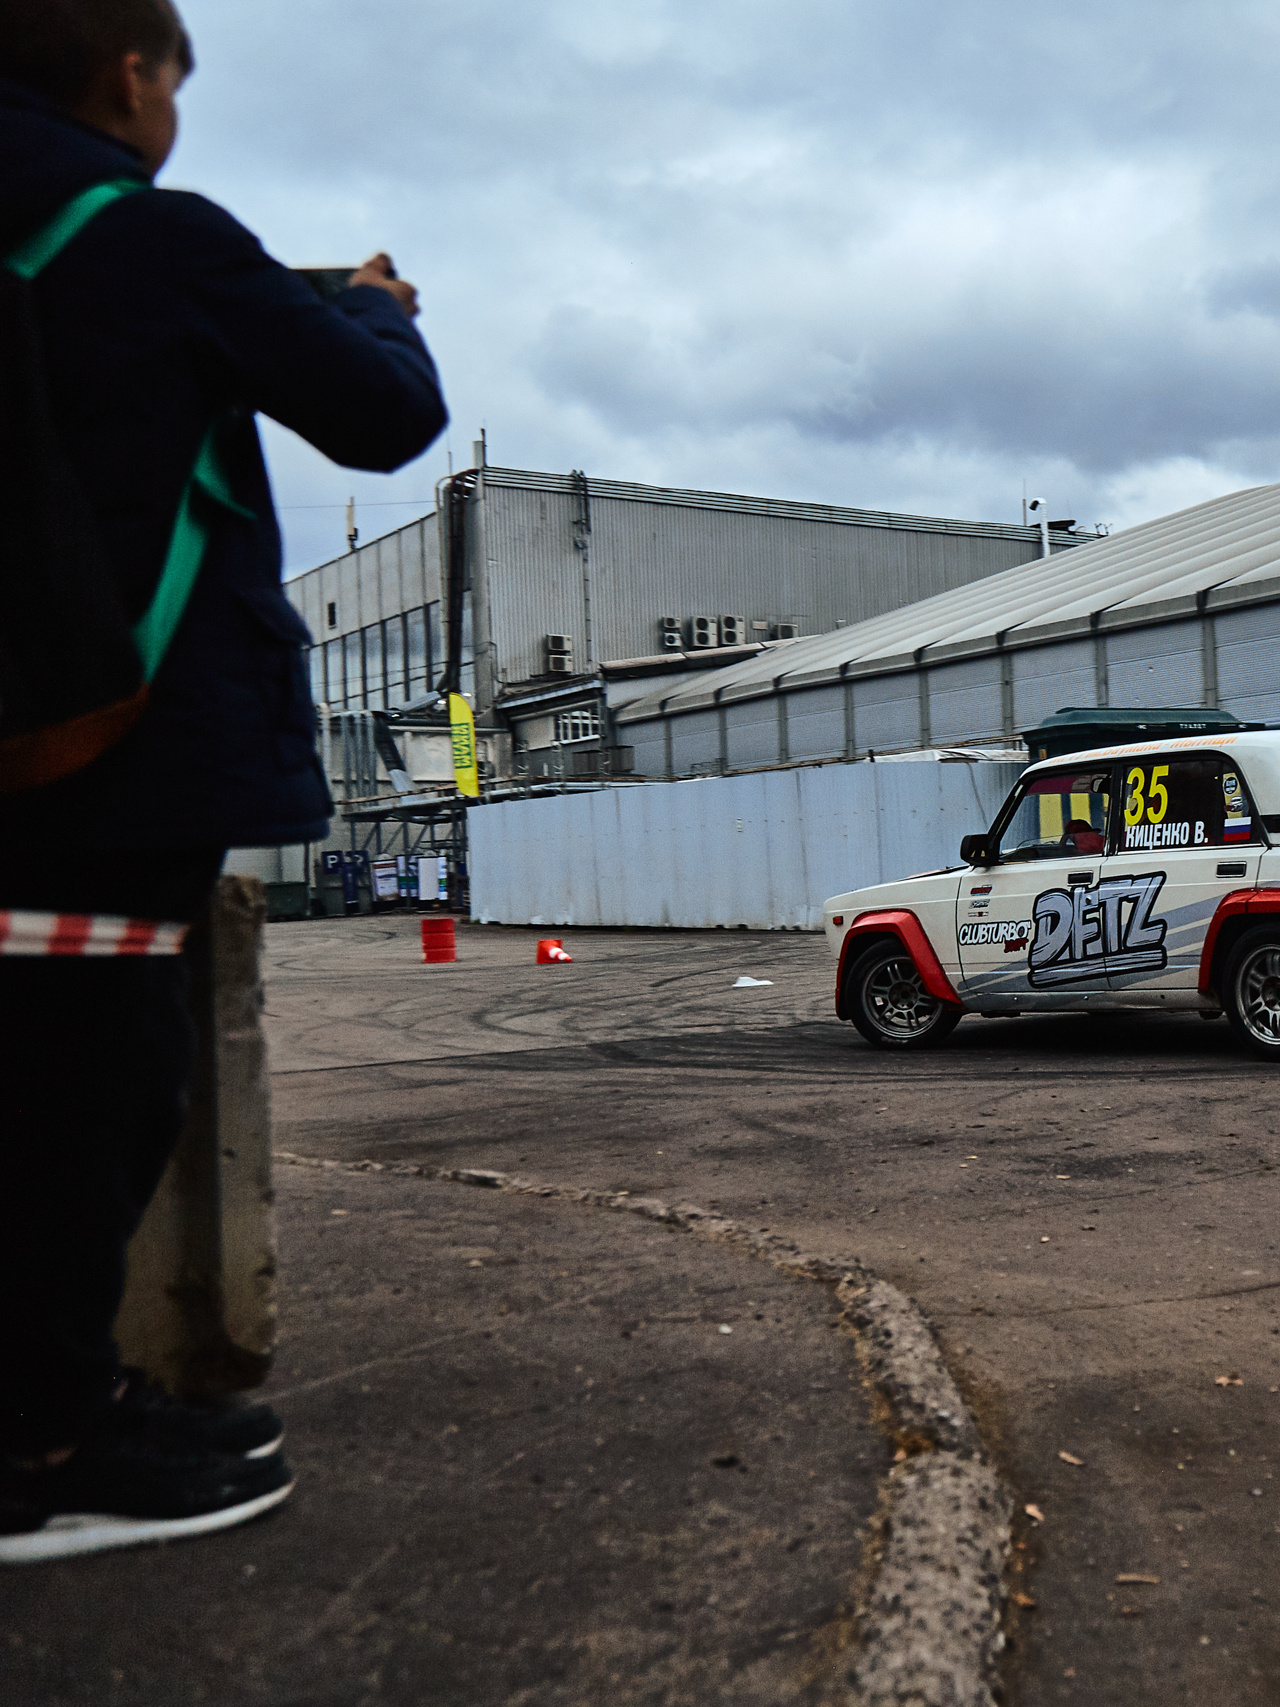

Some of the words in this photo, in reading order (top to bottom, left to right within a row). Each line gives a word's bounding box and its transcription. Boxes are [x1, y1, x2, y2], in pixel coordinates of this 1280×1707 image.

[1124, 765, 1169, 826] 35
[1125, 821, 1190, 850] КИЦЕНКО
[1194, 821, 1209, 844] В.
[959, 919, 1032, 946] CLUBTURBO
[1029, 871, 1167, 970] DETZ
